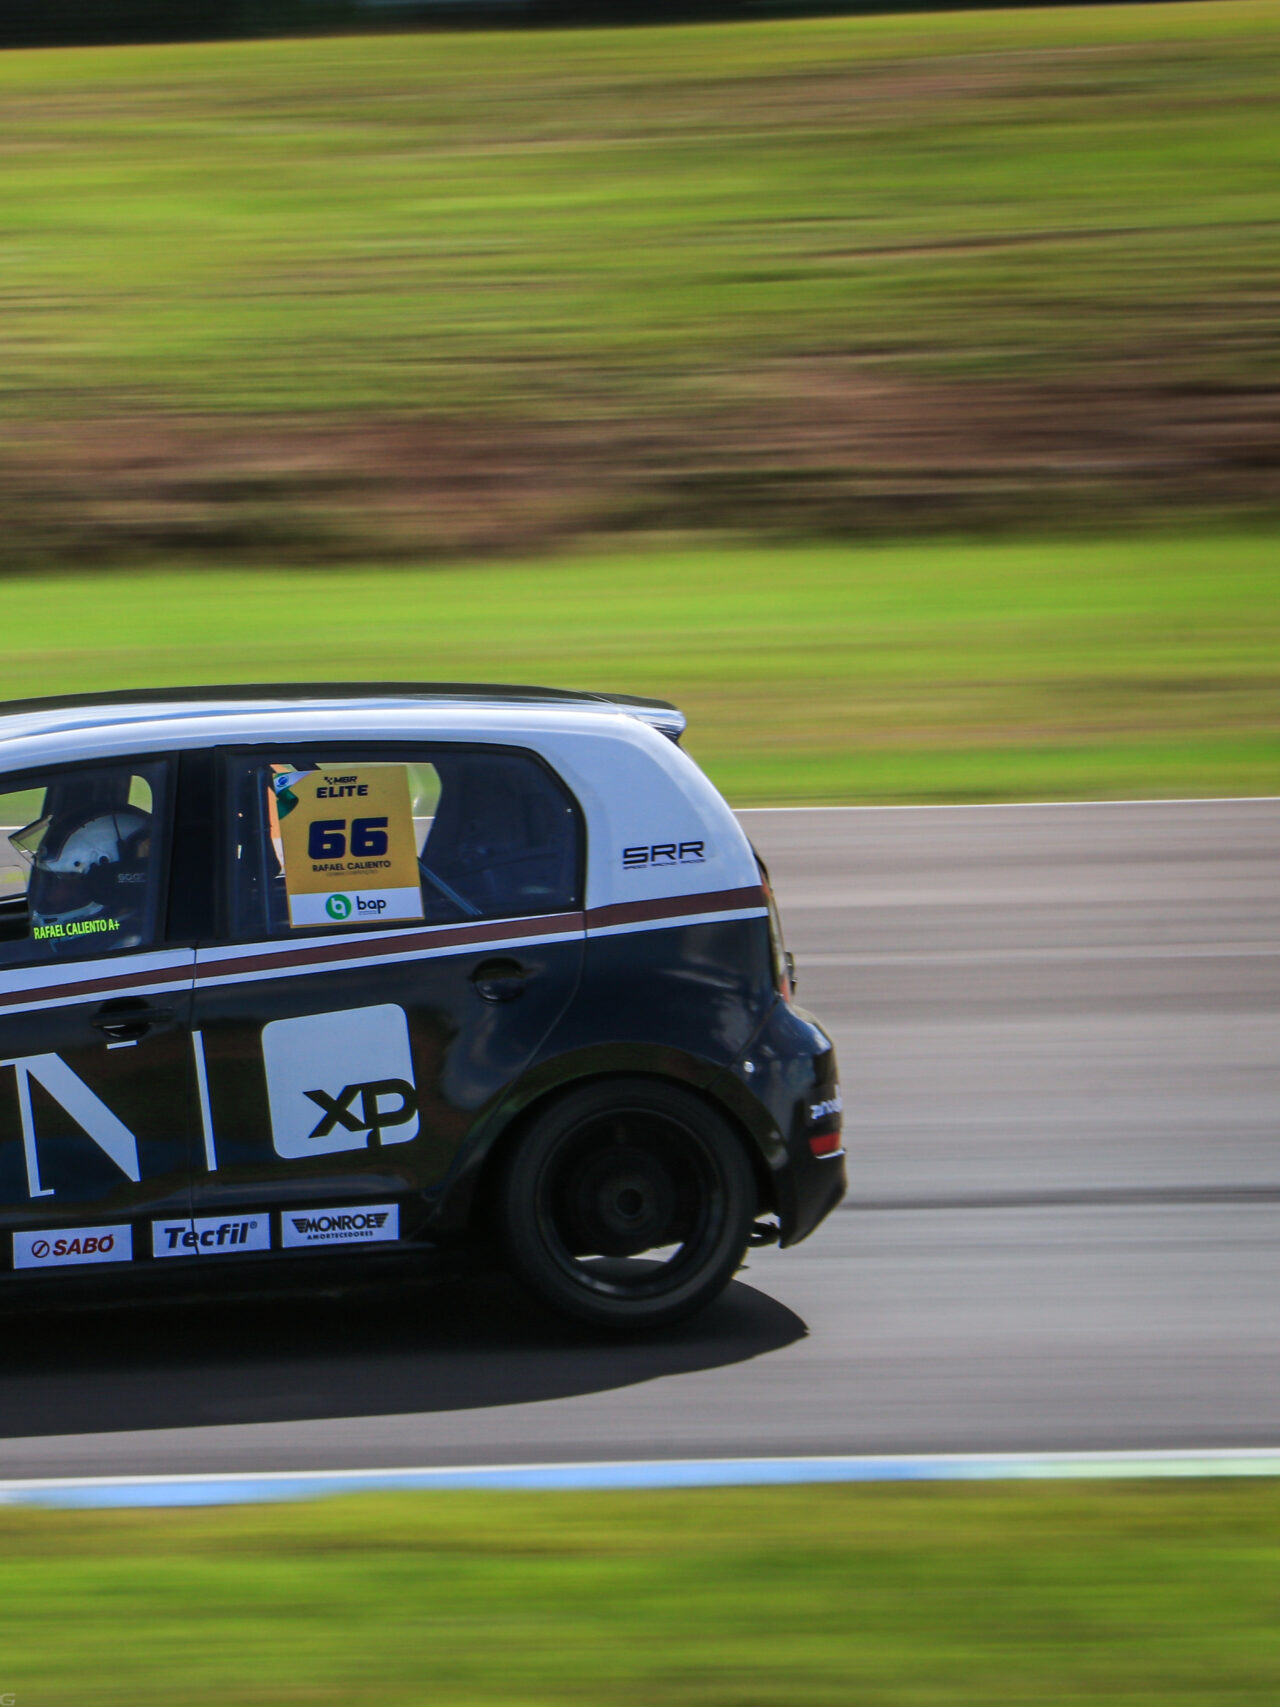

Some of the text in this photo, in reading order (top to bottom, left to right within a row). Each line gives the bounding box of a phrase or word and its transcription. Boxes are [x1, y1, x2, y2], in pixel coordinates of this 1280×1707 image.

[316, 784, 369, 799] ELITE
[307, 816, 389, 860] 66
[623, 841, 704, 865] SRR
[312, 860, 391, 872] RAFAEL CALIENTO
[356, 895, 387, 914] bap
[33, 918, 120, 940] RAFAEL CALIENTO A+
[302, 1078, 418, 1149] XP
[304, 1213, 377, 1233] MONROE
[53, 1234, 115, 1256] SABÓ
[307, 1231, 373, 1240] AMORTECEDORES
